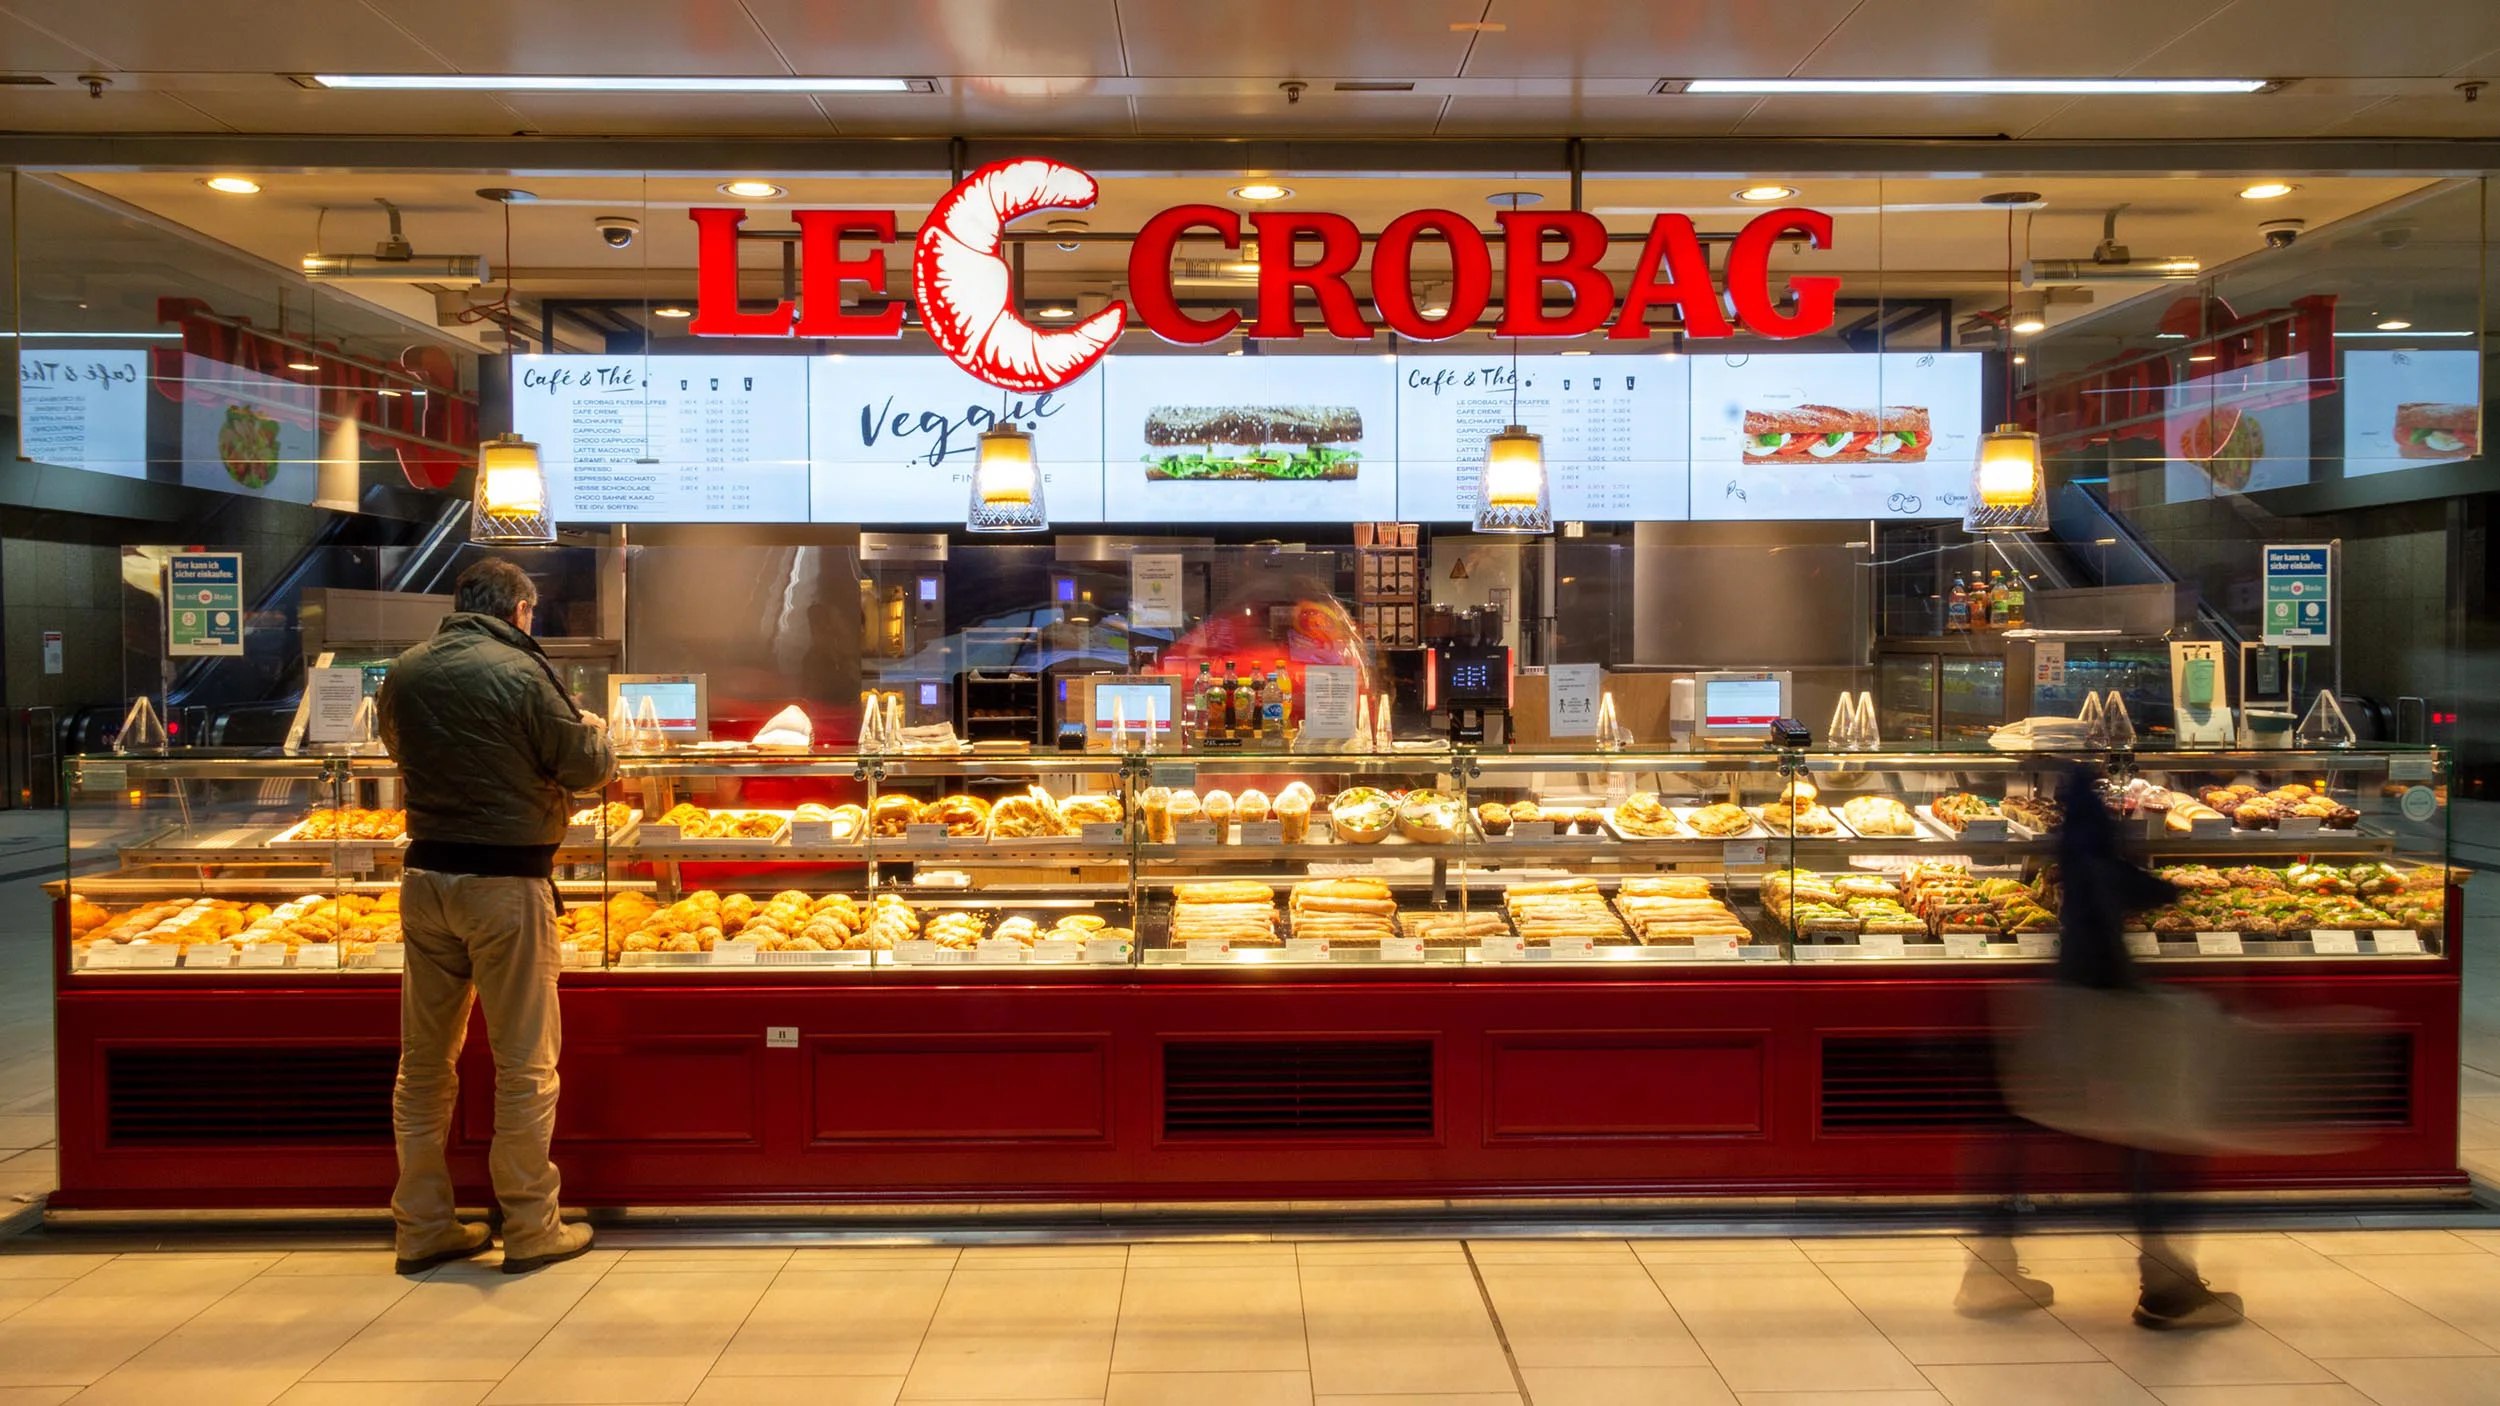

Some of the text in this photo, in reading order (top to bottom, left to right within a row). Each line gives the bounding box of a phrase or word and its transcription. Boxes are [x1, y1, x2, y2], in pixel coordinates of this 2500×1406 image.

[690, 204, 1841, 343] LE CROBAG
[524, 365, 636, 395] Café & Thé
[1409, 366, 1519, 395] Café & Thé
